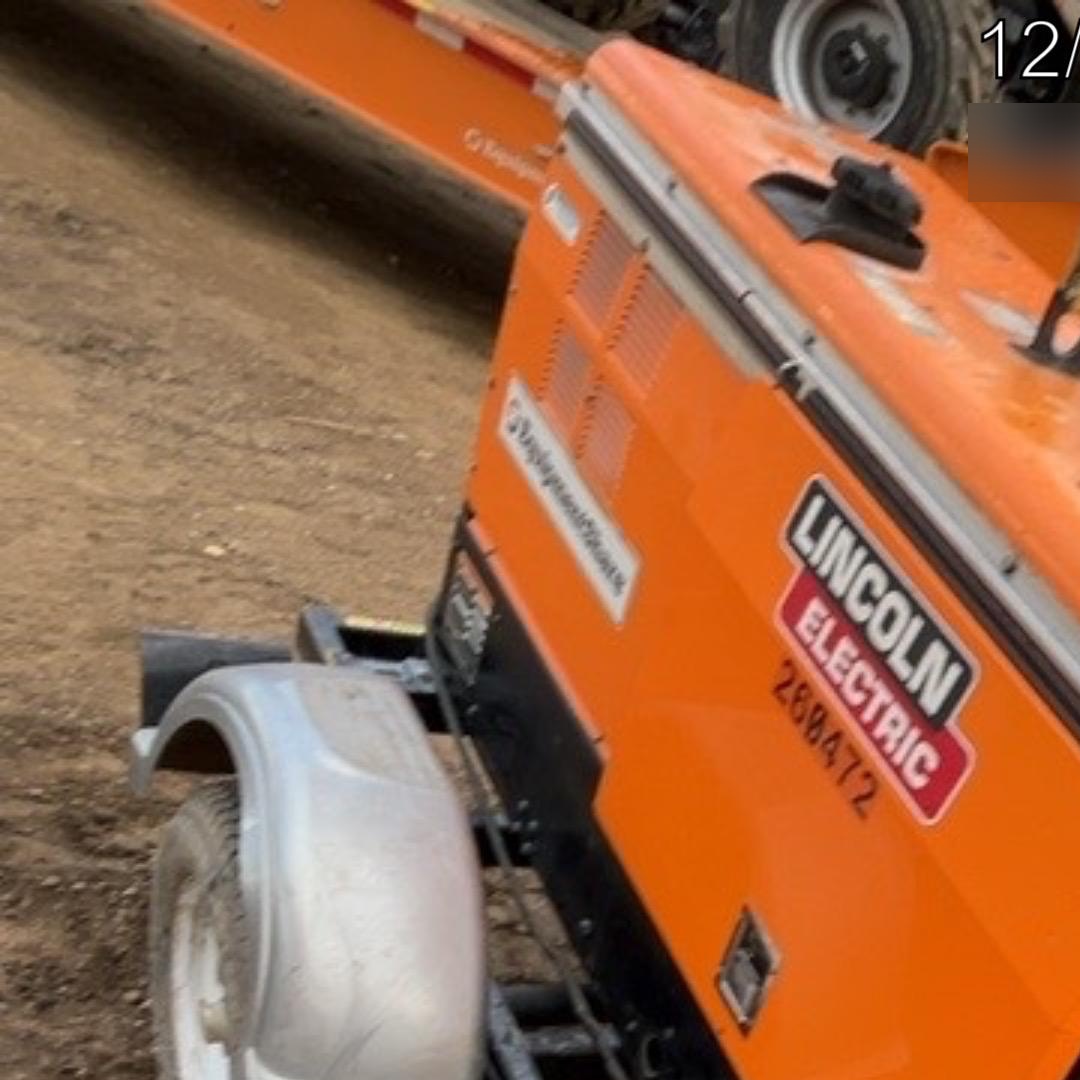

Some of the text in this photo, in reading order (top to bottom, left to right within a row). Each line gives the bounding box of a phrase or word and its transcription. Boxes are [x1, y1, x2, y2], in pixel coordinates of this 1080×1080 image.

[791, 494, 965, 717] LINCOLN
[794, 596, 942, 790] ELECTRIC
[772, 658, 879, 819] 260472
